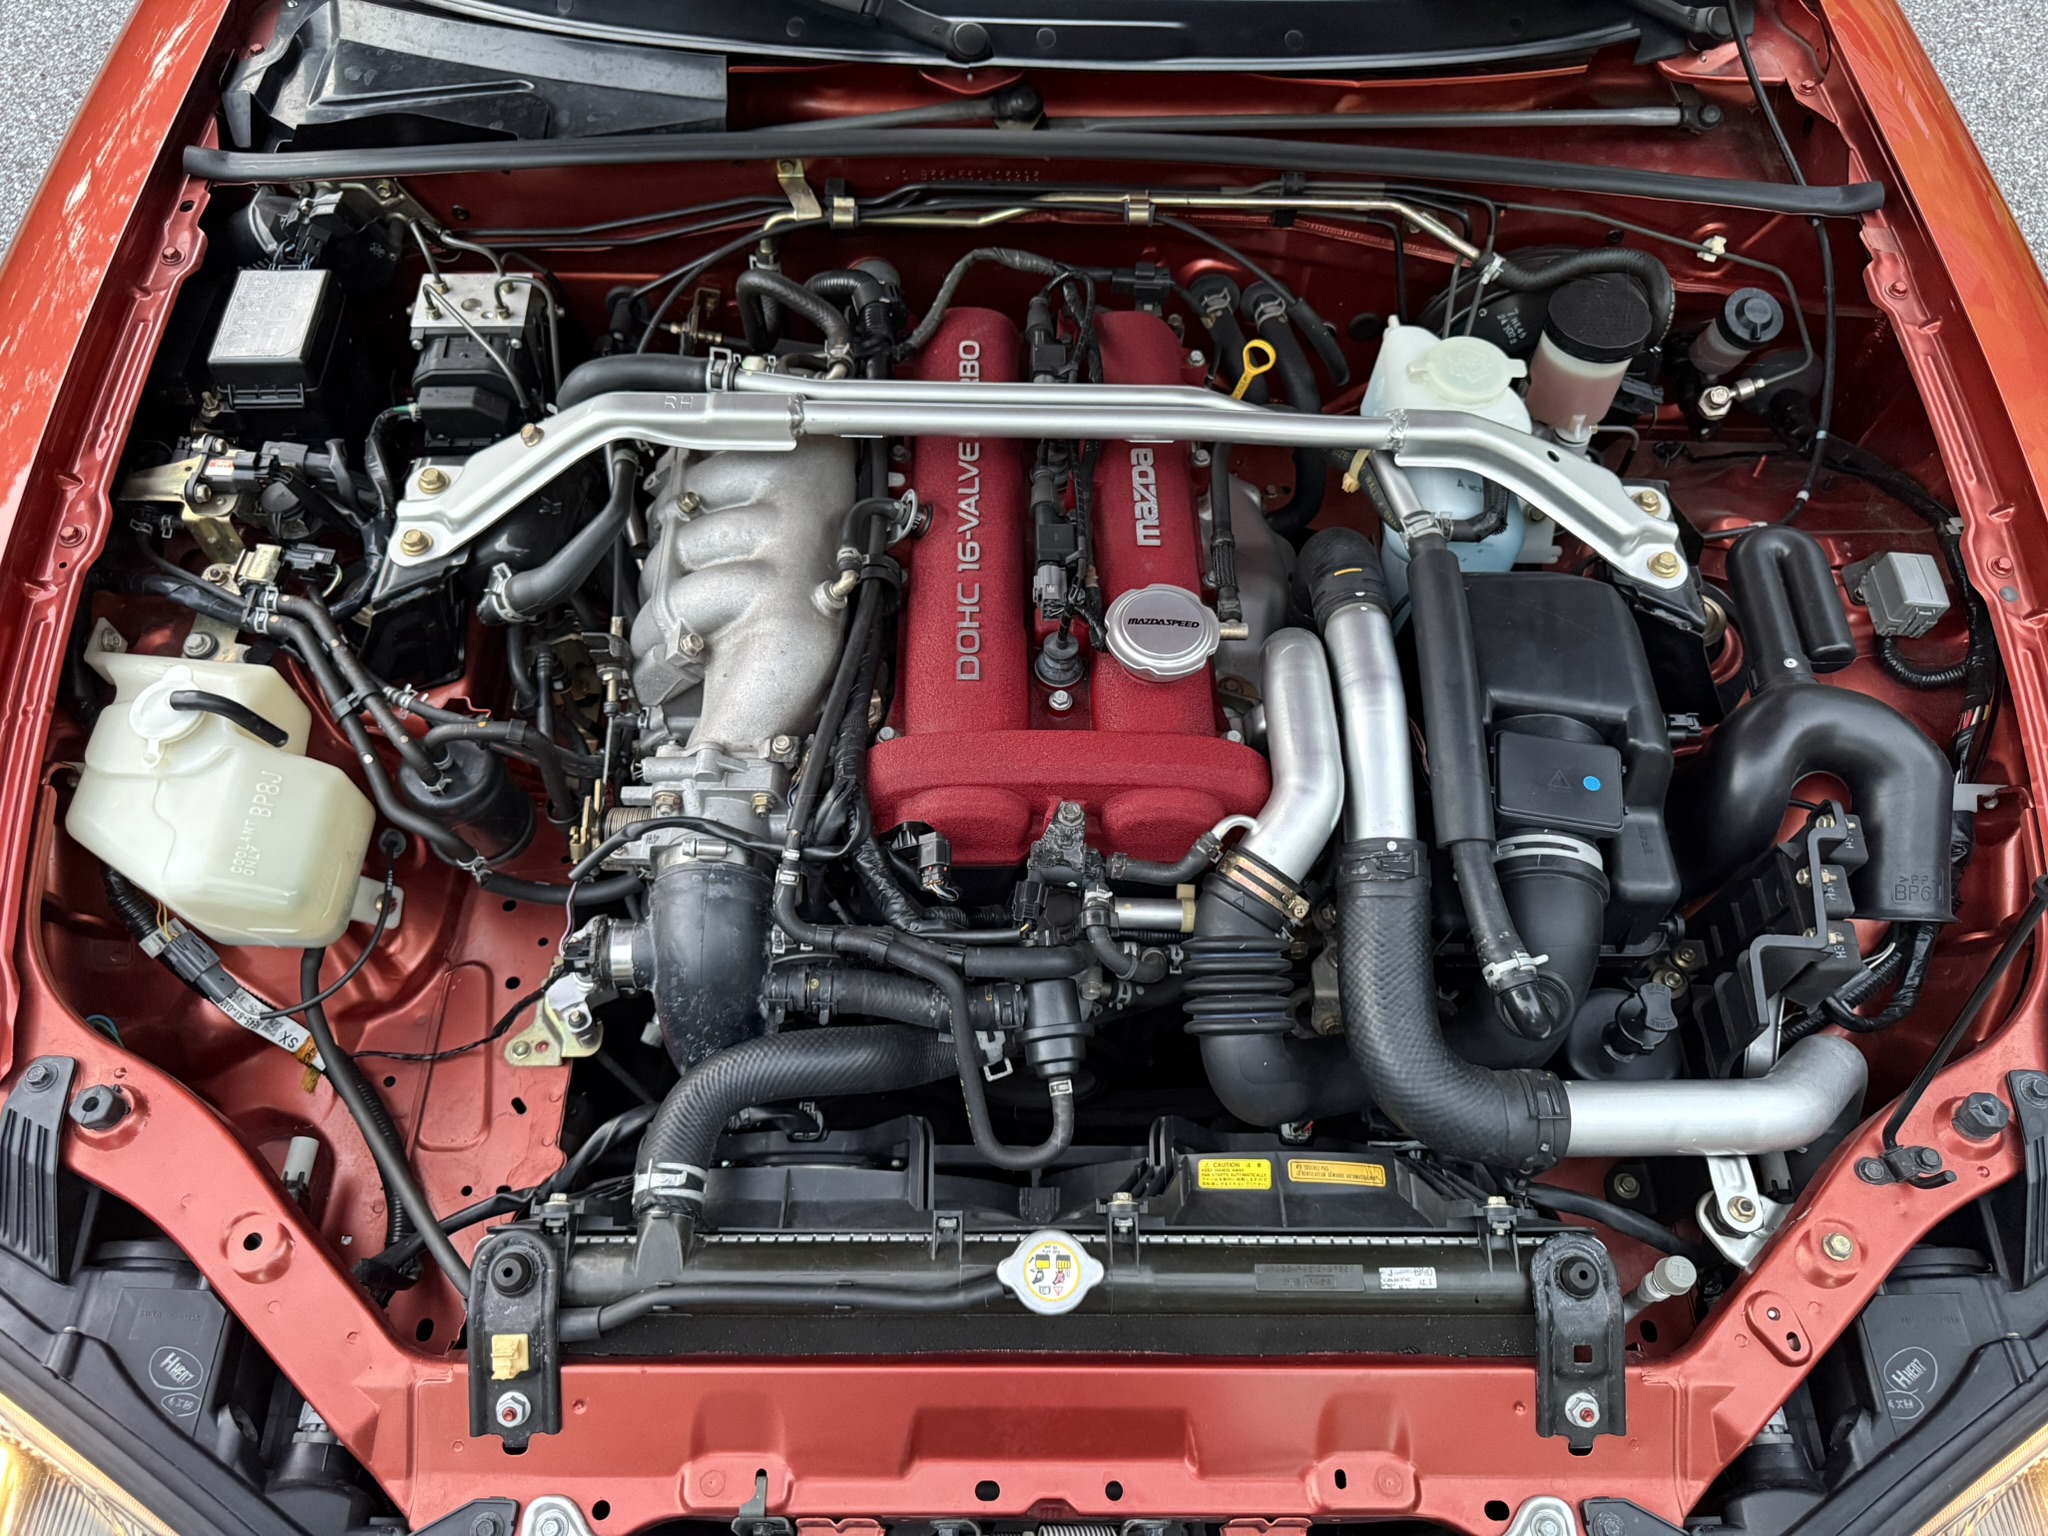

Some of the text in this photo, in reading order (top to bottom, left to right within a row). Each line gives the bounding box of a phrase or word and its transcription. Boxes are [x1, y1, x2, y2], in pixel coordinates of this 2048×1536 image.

[664, 395, 694, 409] RH
[956, 442, 981, 681] DOHC 16-VALVE
[1127, 617, 1200, 629] MAZDASPEED
[249, 770, 283, 818] BP8J
[243, 845, 261, 877] ONLY
[278, 1030, 299, 1049] SX
